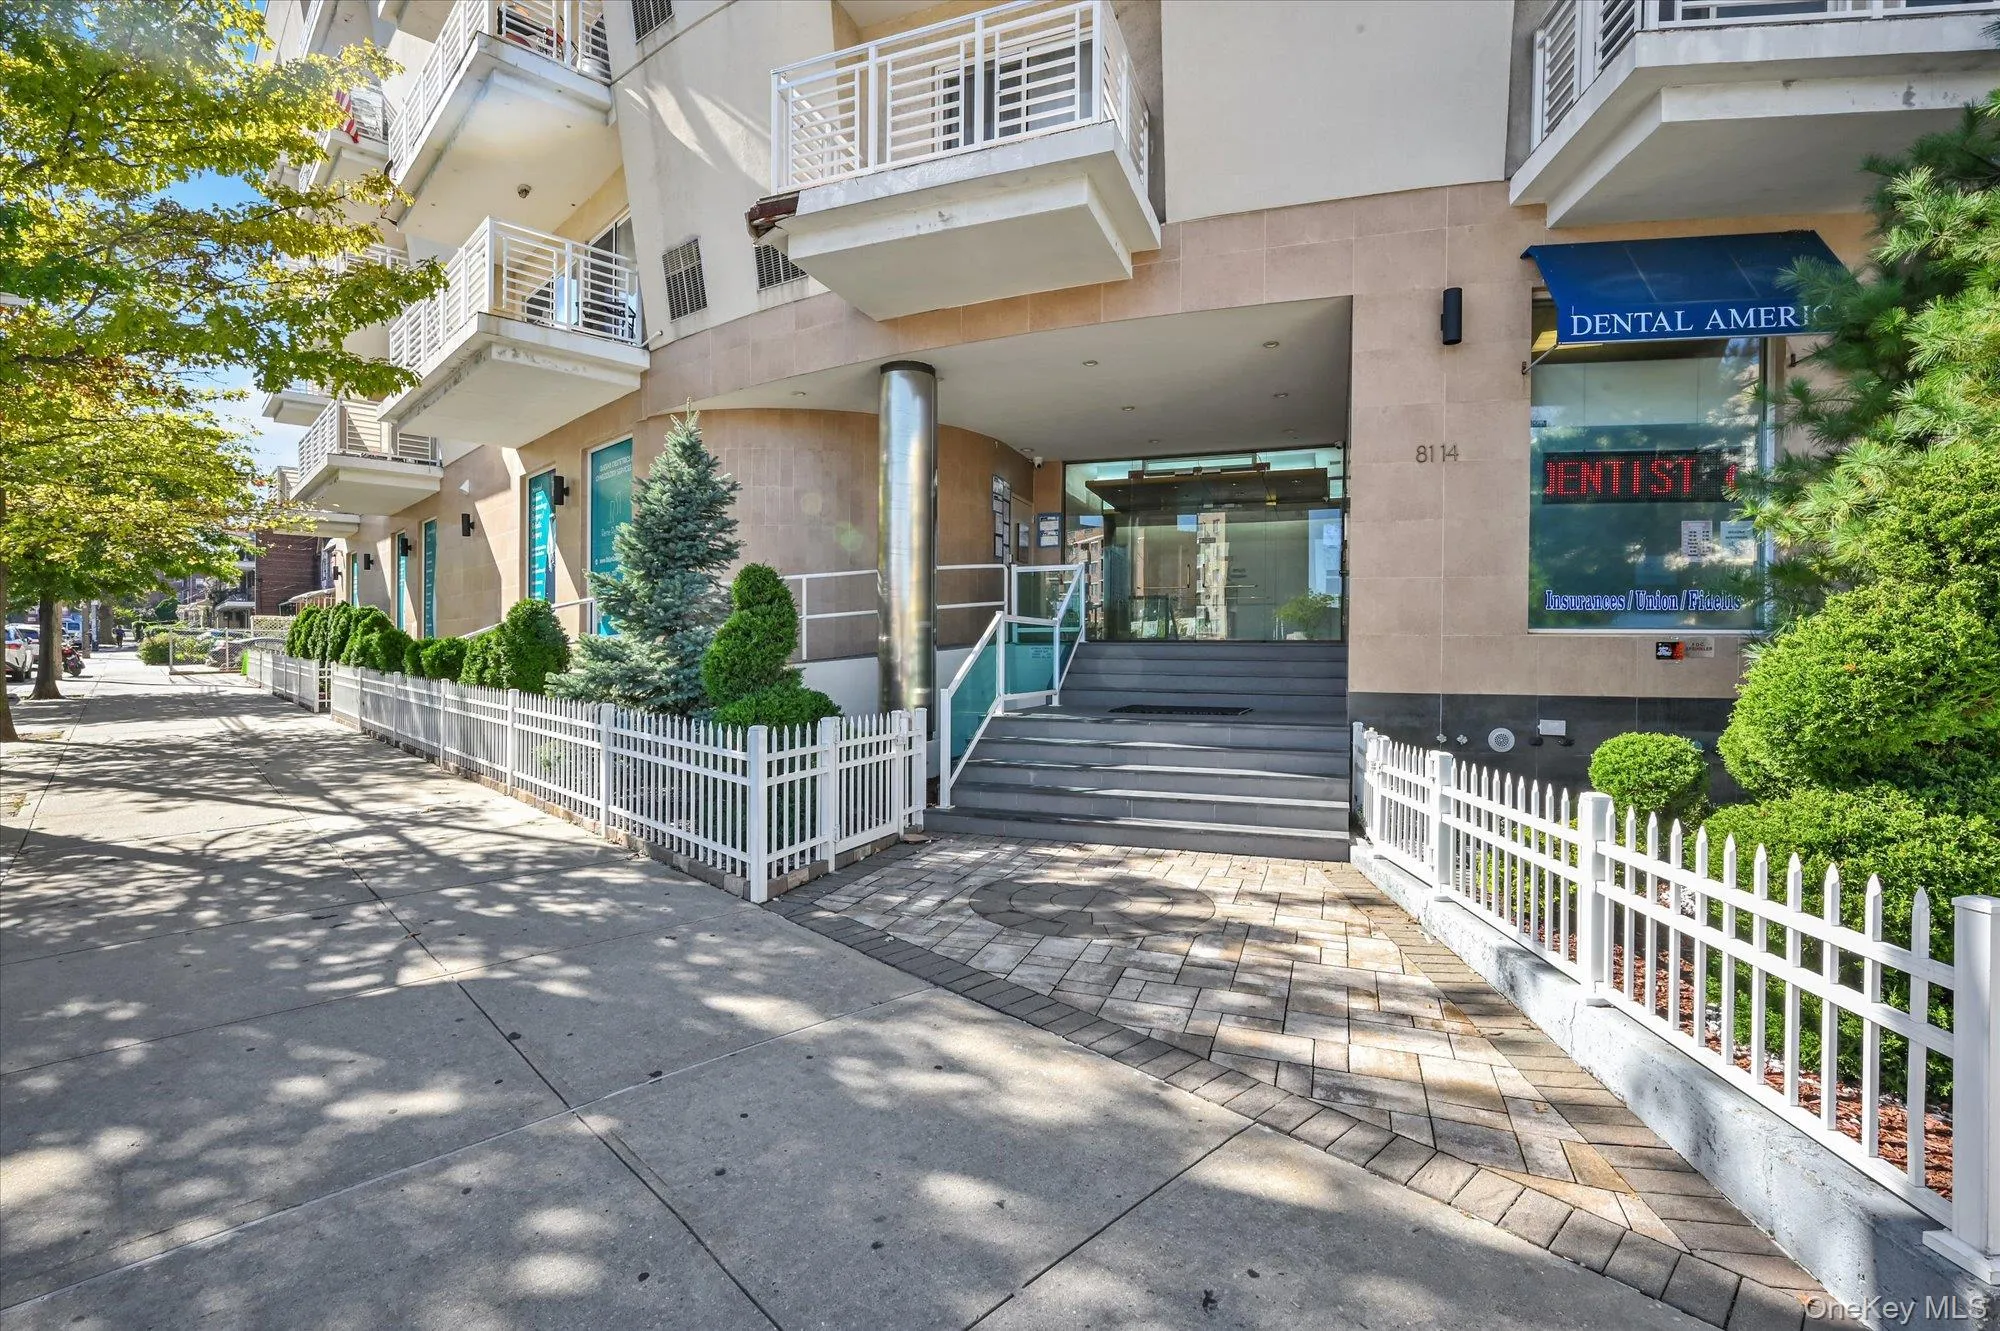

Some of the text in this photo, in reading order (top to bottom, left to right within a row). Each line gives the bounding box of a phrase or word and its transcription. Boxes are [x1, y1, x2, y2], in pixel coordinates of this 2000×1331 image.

[1571, 304, 1847, 336] DENTAL AMERIC
[1415, 443, 1459, 463] 8114
[1545, 589, 1625, 611] Insurances
[1635, 589, 1678, 611] Union
